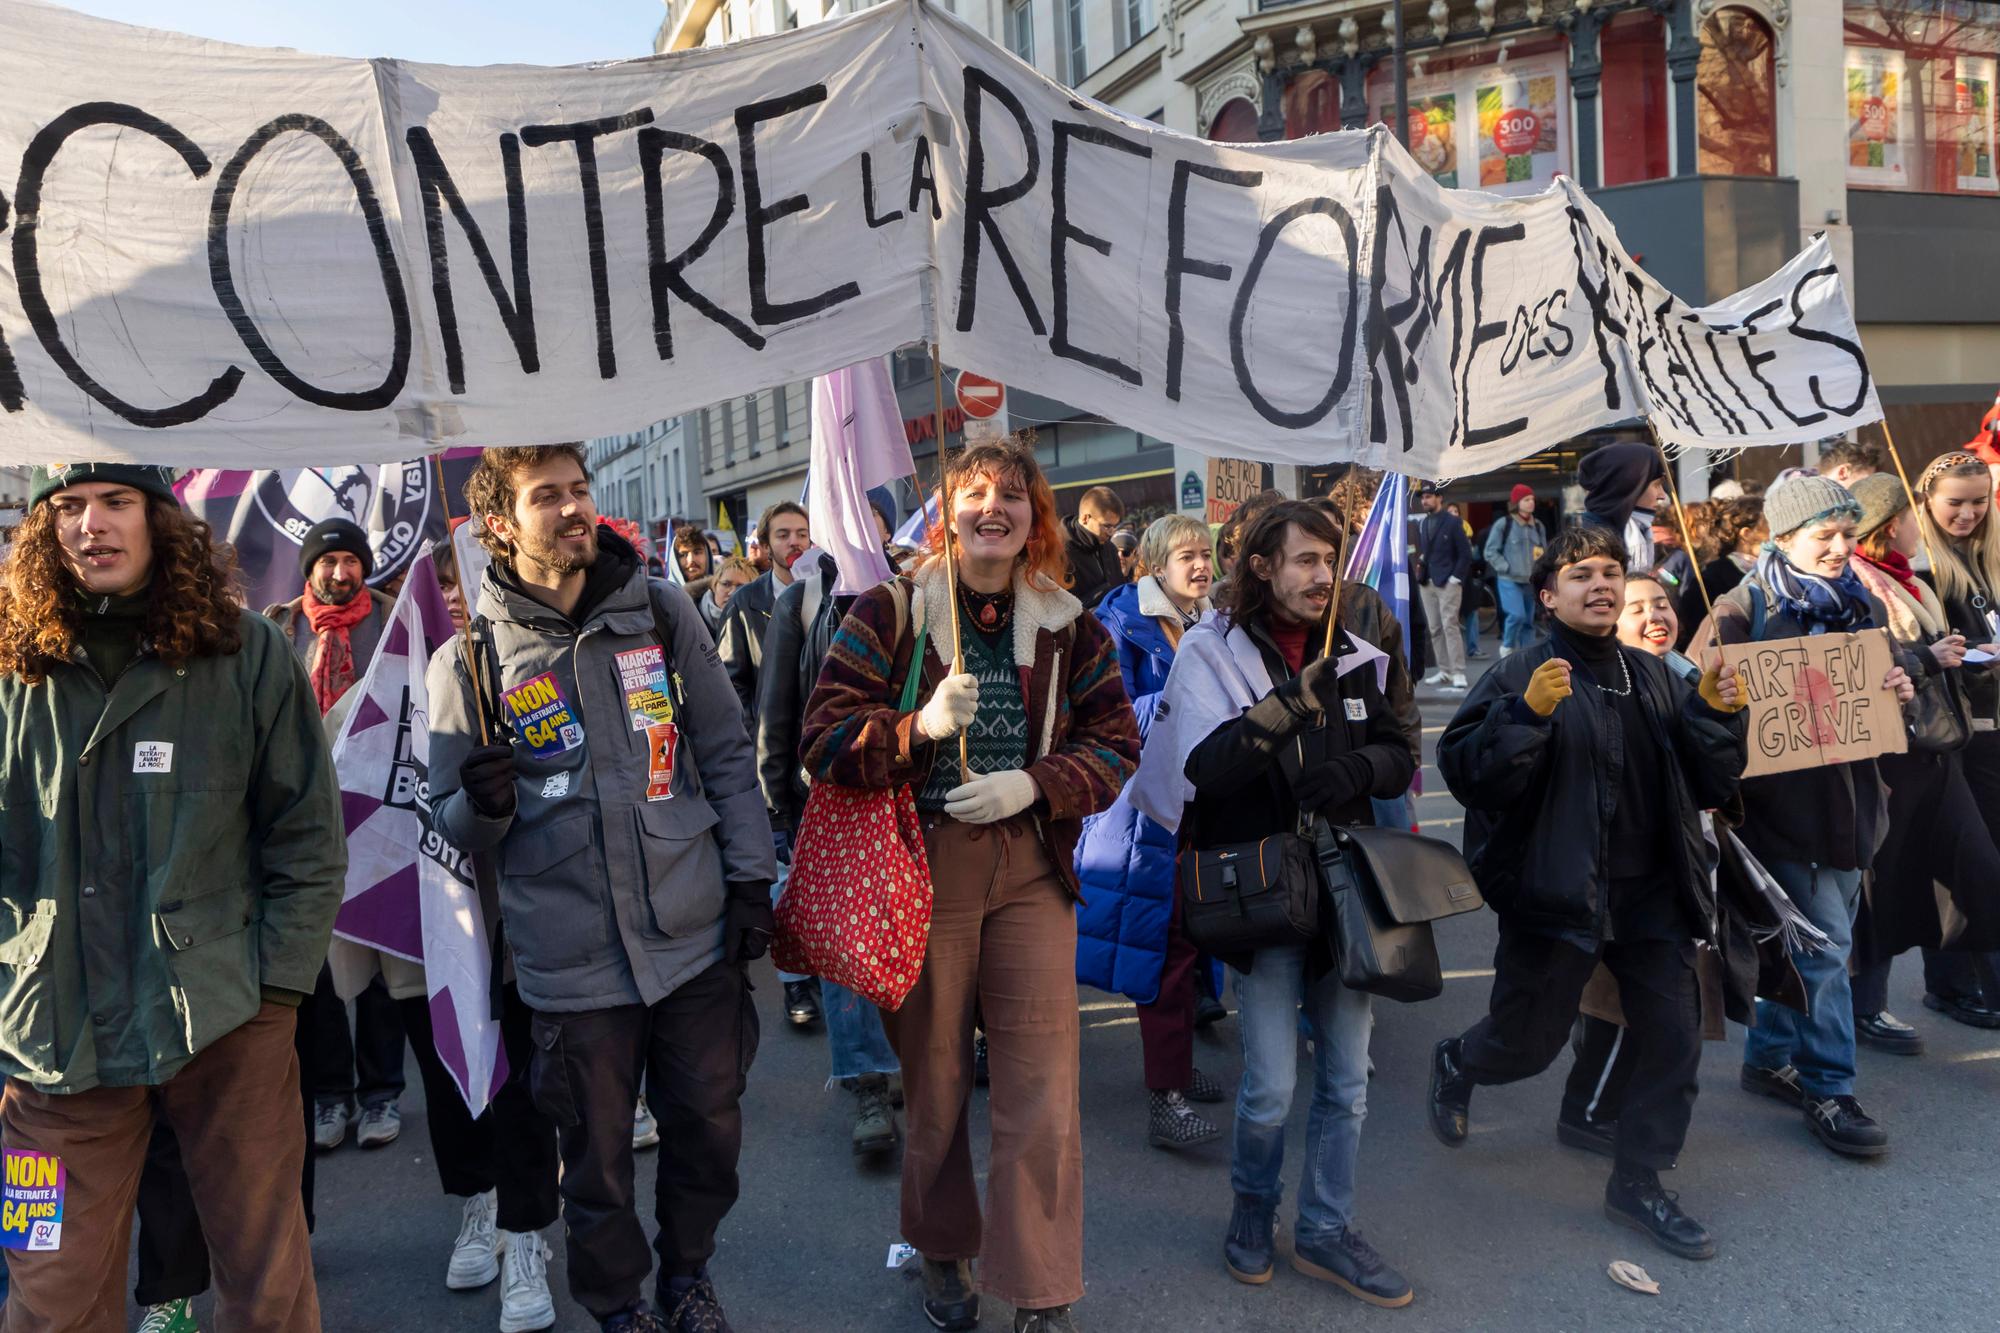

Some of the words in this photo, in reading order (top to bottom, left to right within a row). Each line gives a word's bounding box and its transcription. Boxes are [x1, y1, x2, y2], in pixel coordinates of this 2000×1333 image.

[1500, 116, 1534, 134] 300
[12, 83, 861, 428] CONTRE
[862, 137, 941, 227] LA
[1500, 288, 1574, 377] DES
[617, 648, 662, 671] MARCHE
[621, 669, 635, 678] POUR
[635, 666, 647, 676] NOS
[623, 670, 665, 690] RETRAITES
[1738, 648, 1810, 702] ART
[1824, 644, 1867, 699] EN
[507, 677, 559, 717] NON
[646, 699, 668, 711] PARIS
[525, 715, 533, 724] LA
[531, 703, 559, 722] RETRAITE
[525, 719, 558, 748] 64
[550, 710, 571, 728] ANS
[6, 1154, 58, 1187] NON
[15, 1189, 50, 1200] RETRAITE
[51, 1188, 58, 1199] À
[2, 1200, 29, 1233] 64
[28, 1202, 57, 1217] ANS
